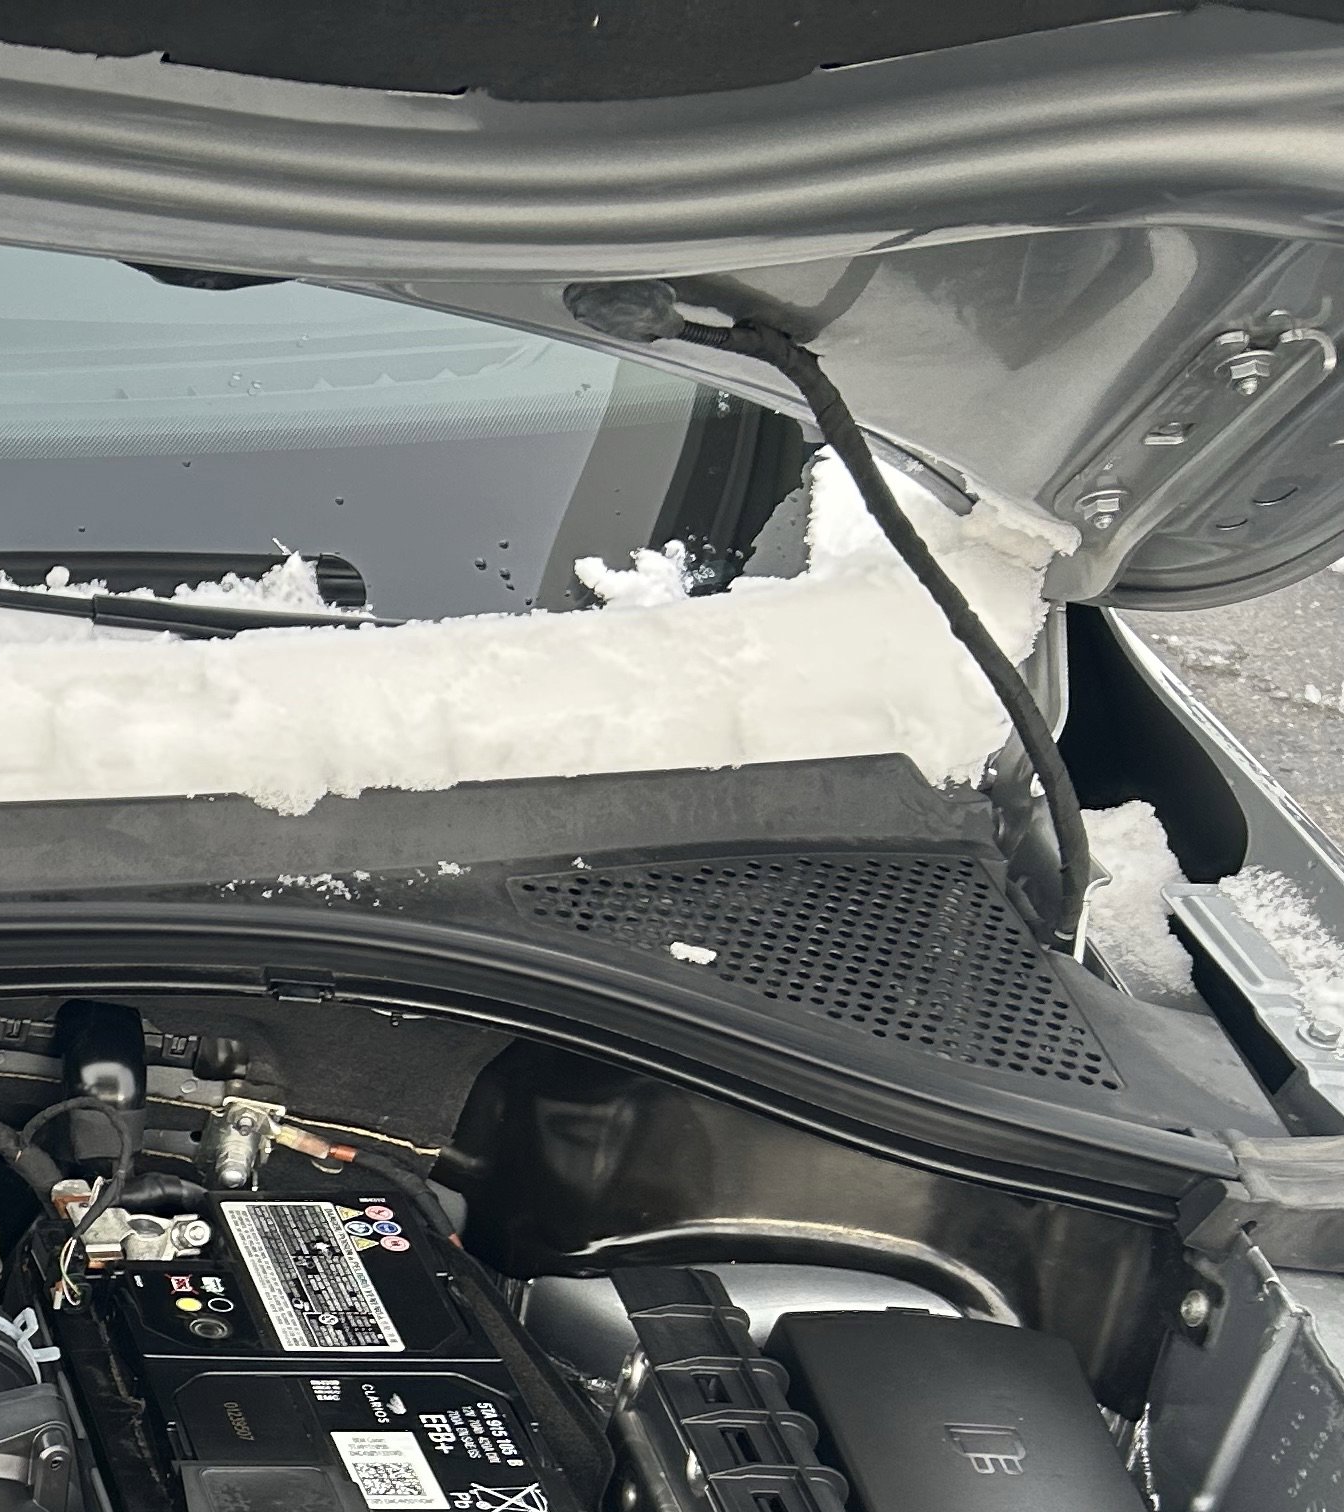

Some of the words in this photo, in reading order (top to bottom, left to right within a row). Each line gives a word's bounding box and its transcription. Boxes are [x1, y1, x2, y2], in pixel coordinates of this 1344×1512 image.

[362, 1383, 390, 1424] CLARIOS
[419, 1414, 456, 1455] EFB+
[489, 1419, 508, 1437] 915
[450, 1492, 473, 1509] Pb
